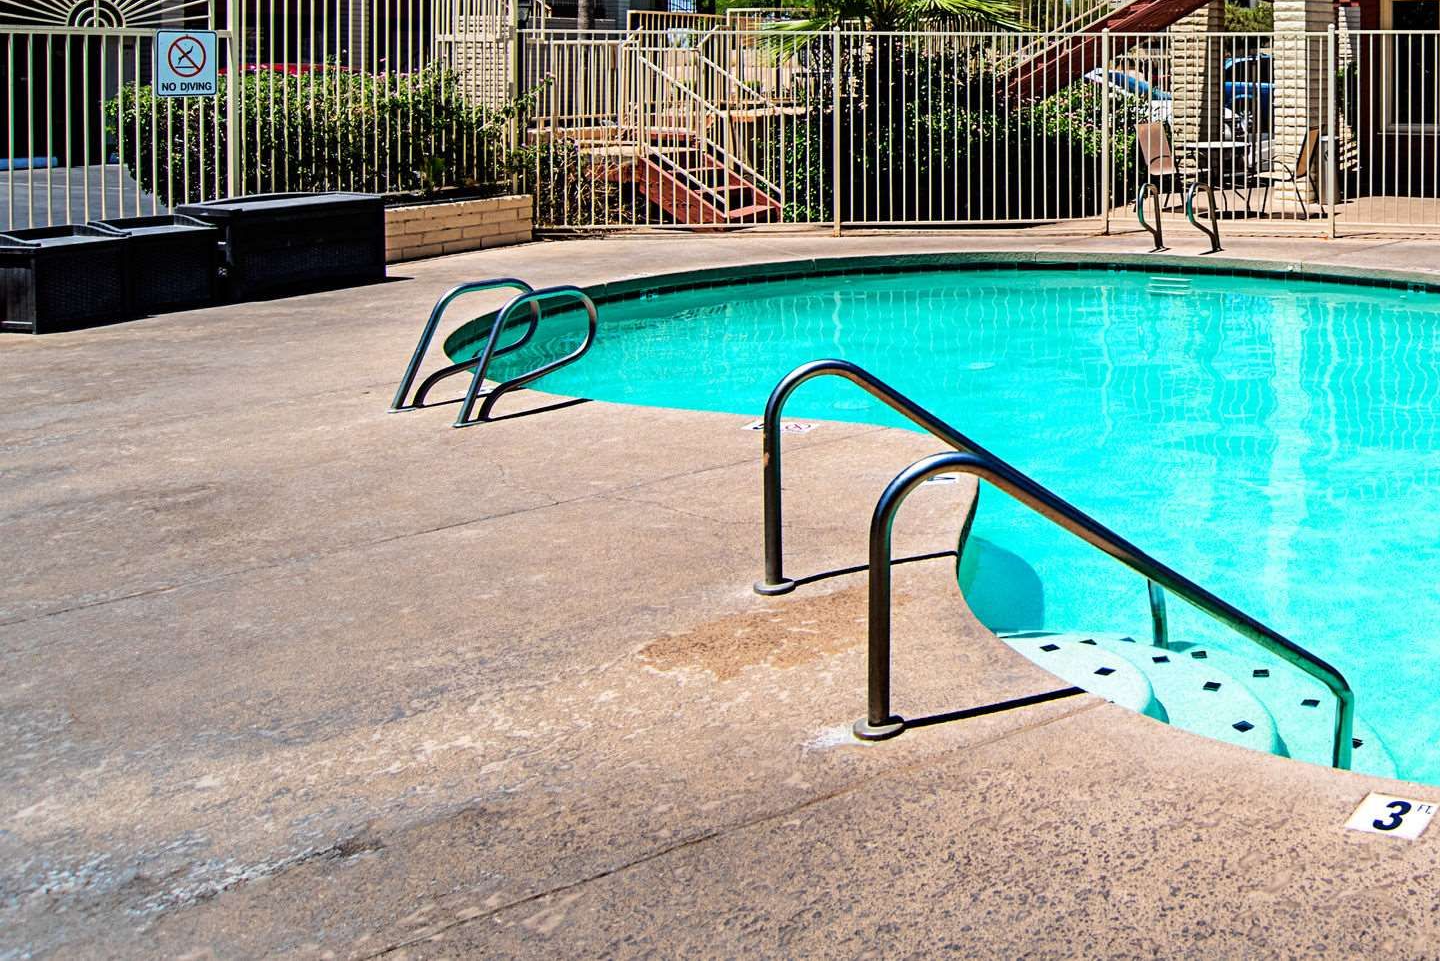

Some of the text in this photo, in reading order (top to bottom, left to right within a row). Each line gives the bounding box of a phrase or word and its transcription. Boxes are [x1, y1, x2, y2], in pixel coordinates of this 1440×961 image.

[161, 82, 212, 92] NO DIVING
[1372, 801, 1412, 831] 3
